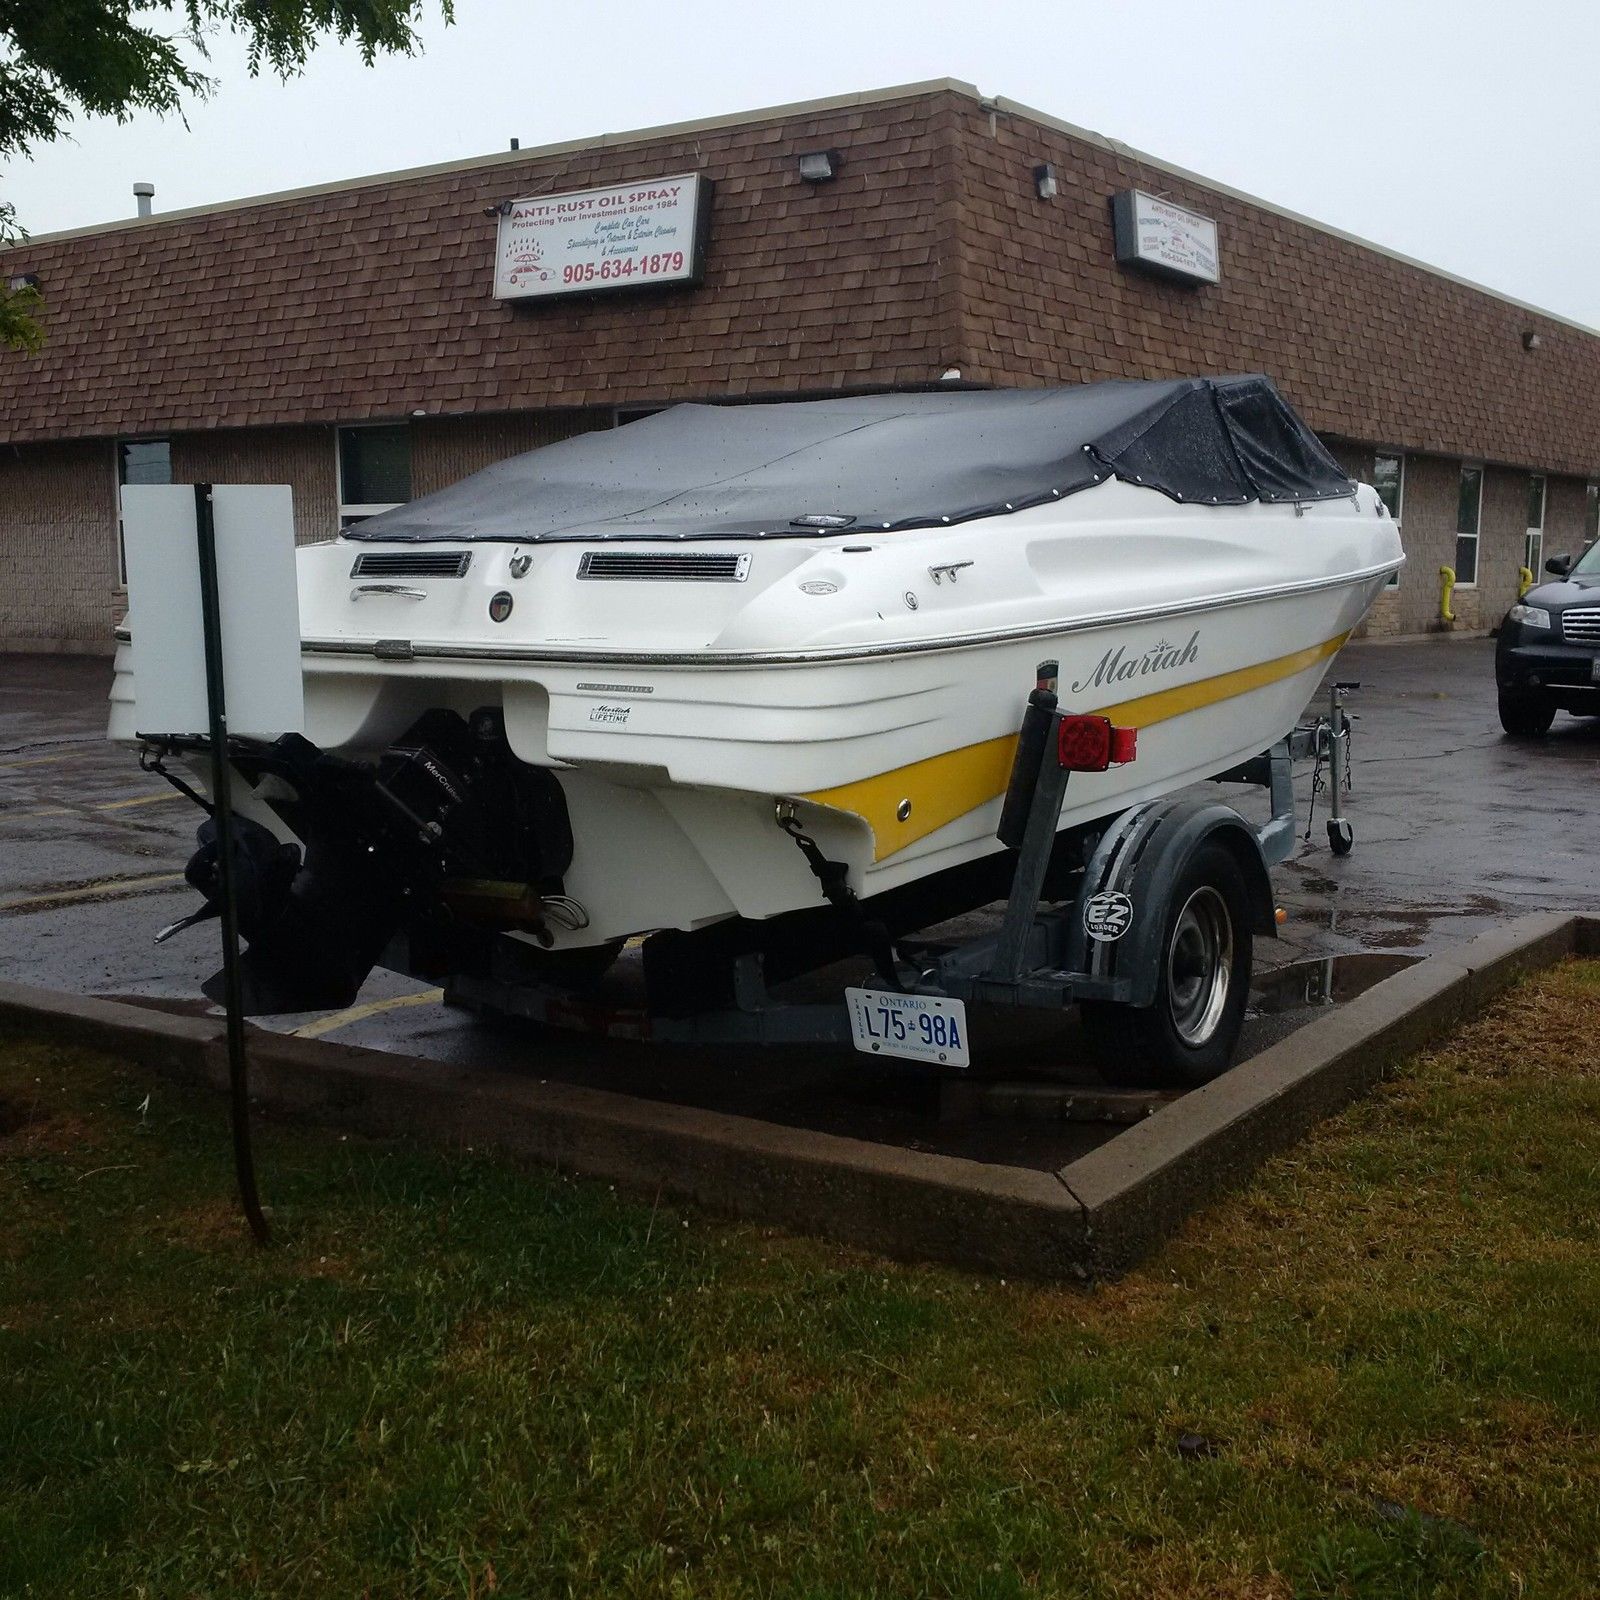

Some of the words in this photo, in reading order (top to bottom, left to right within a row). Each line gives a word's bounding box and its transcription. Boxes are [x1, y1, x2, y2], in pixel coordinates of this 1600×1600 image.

[511, 218, 555, 230] Protecting
[557, 214, 576, 223] Your
[579, 207, 627, 220] Investment
[629, 203, 653, 212] Since
[656, 199, 678, 209] 1984
[513, 199, 595, 219] ANTI-RUST
[598, 196, 625, 208] OIL
[628, 186, 681, 203] SPRAY
[621, 217, 634, 231] Car
[635, 215, 651, 228] Care
[563, 251, 684, 284] 905-634-1879
[1071, 630, 1200, 693] Mariah
[590, 713, 628, 723] LIFETIME
[1088, 904, 1129, 926] EZ
[1090, 923, 1119, 934] LOADER
